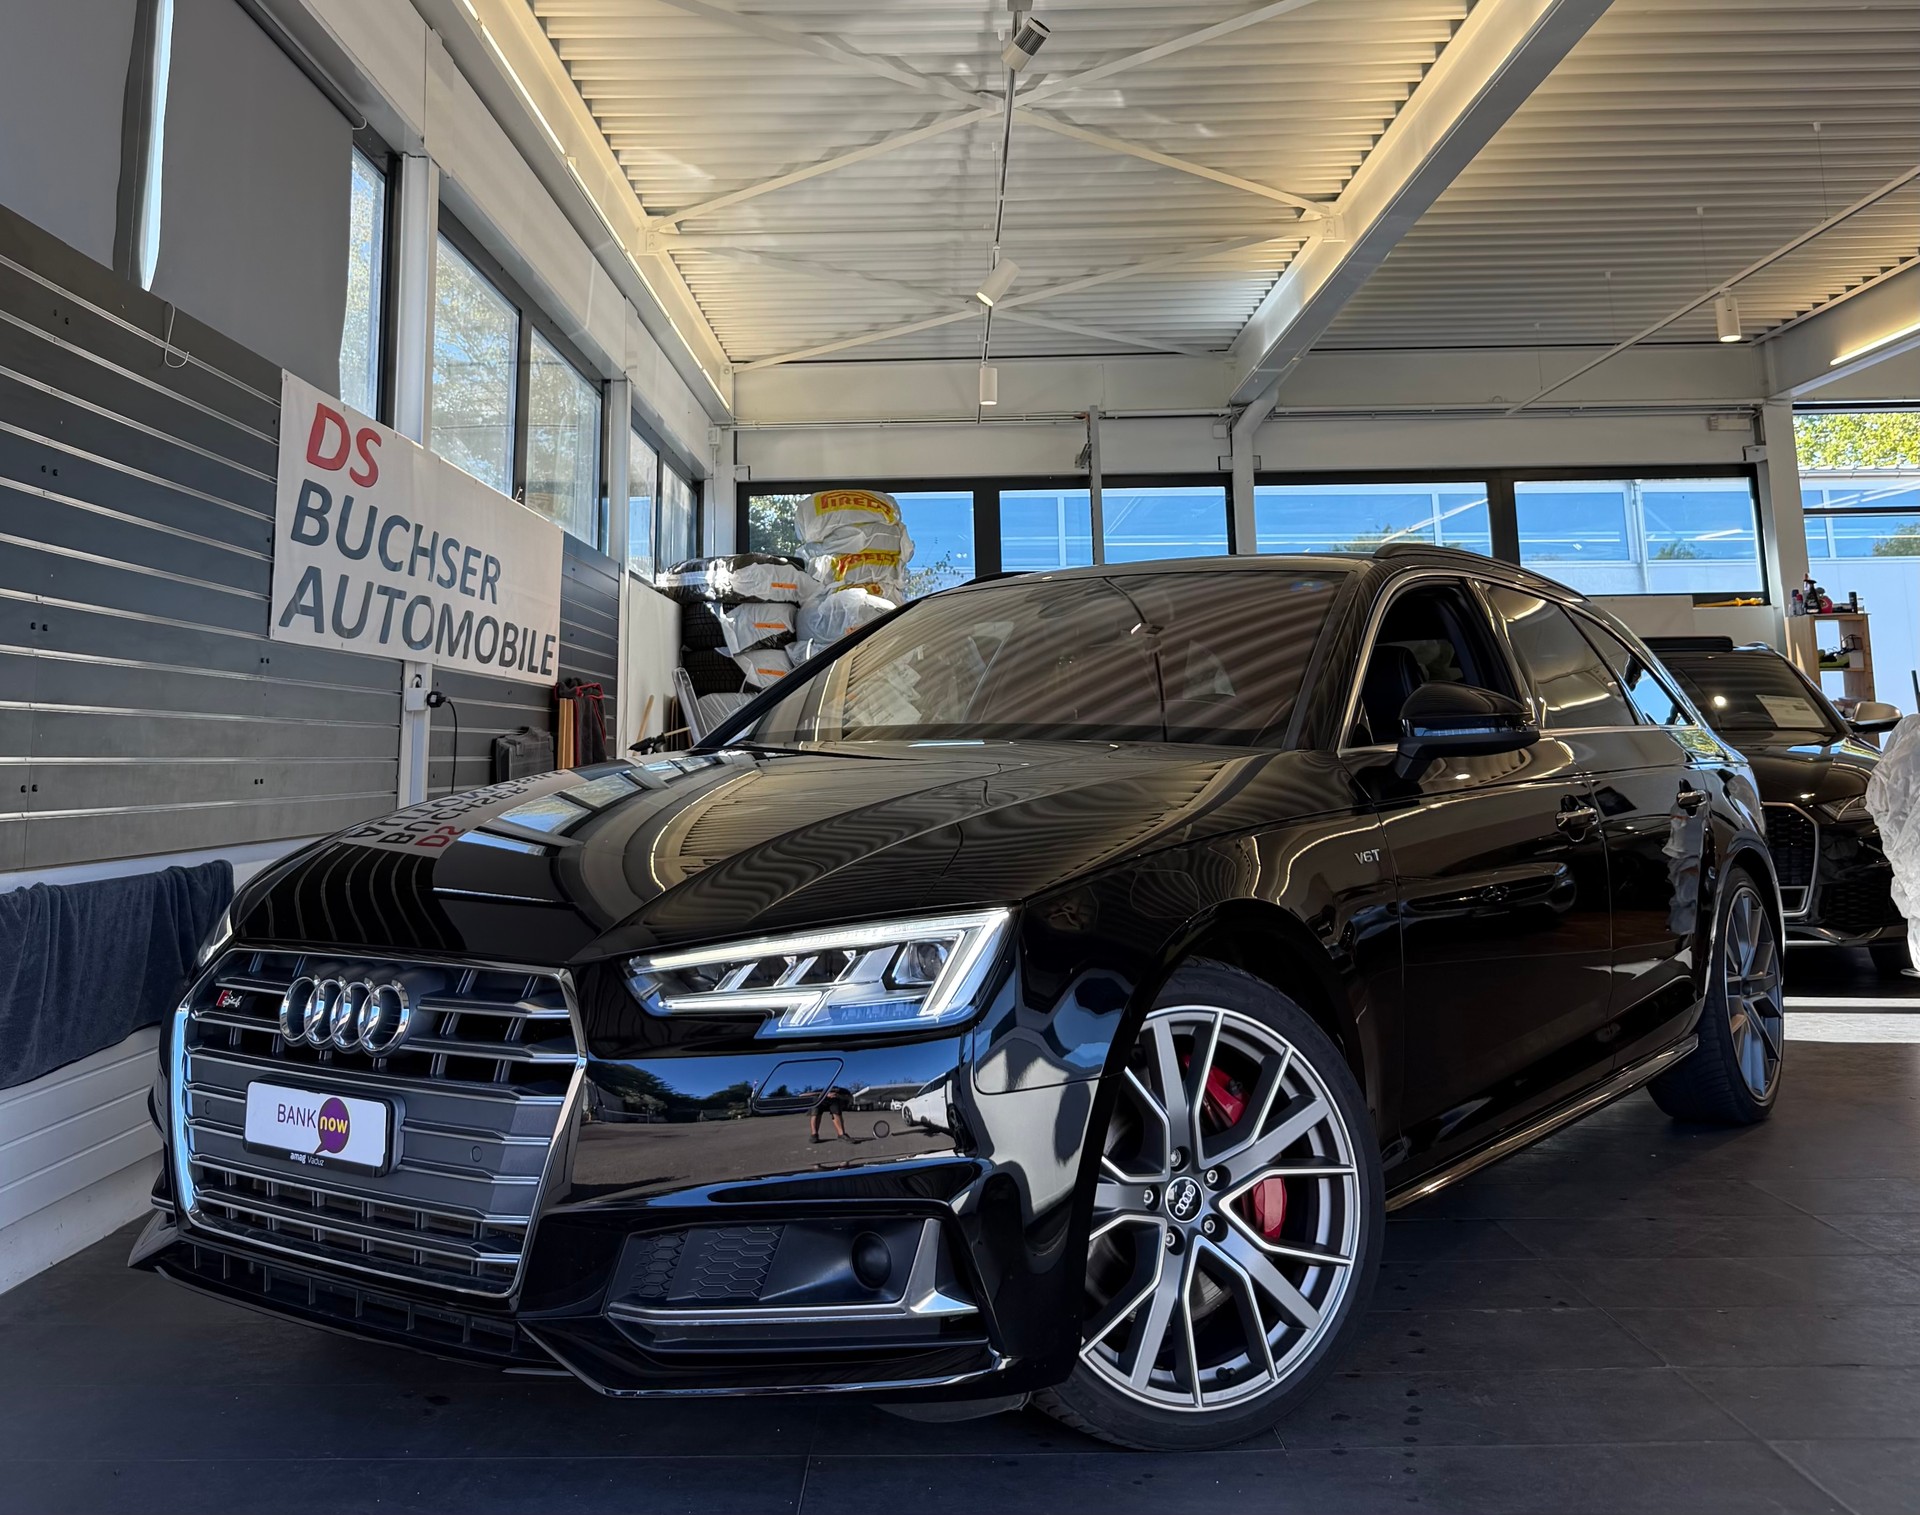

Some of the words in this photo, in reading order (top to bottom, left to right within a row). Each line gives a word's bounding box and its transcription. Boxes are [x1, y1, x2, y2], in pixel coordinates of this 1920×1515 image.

[306, 402, 382, 488] DS
[290, 478, 501, 605] BUCHSER
[278, 565, 556, 676] AUTOMOBILE
[1354, 848, 1380, 865] V6T
[277, 1103, 317, 1129] BANK
[320, 1115, 348, 1134] now
[290, 1152, 306, 1164] amag
[307, 1156, 325, 1167] Vaduz
